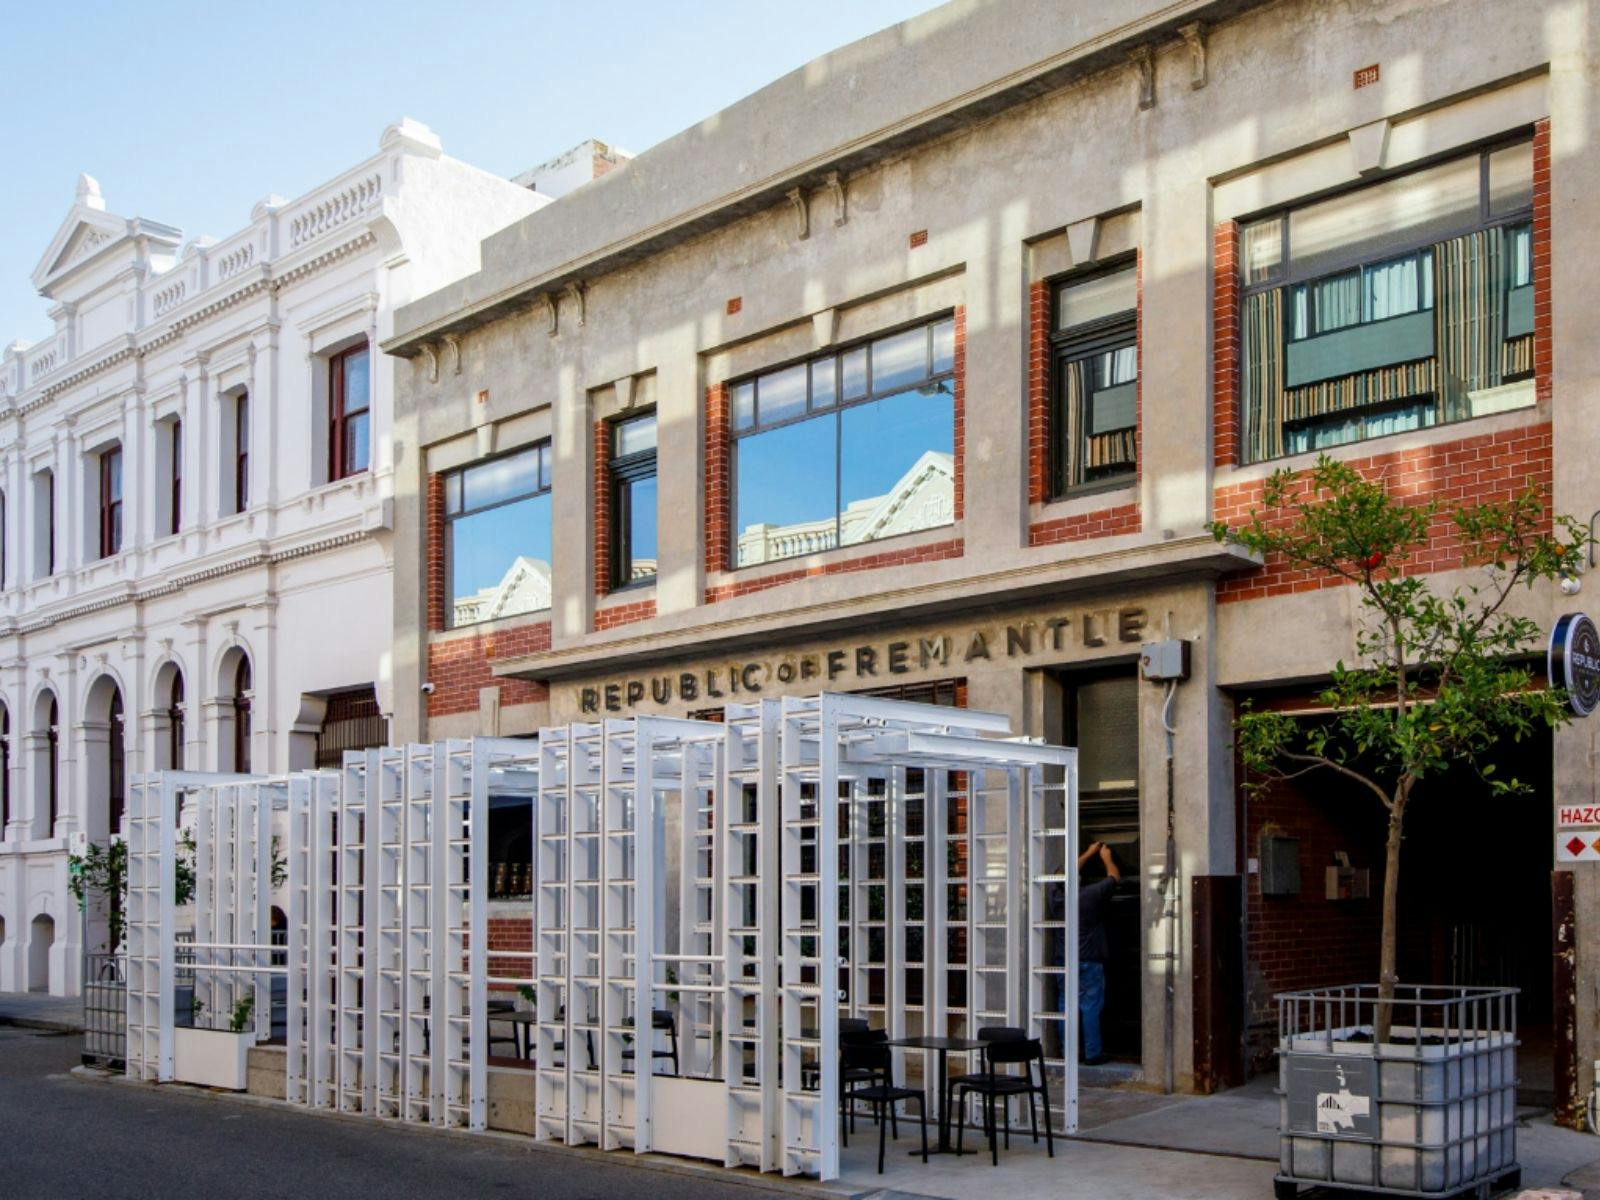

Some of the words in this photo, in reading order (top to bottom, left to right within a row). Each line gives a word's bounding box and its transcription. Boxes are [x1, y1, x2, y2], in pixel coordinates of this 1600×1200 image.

[581, 663, 763, 713] REPUBLIC
[777, 658, 818, 683] OF
[827, 607, 1147, 680] FREMANTLE
